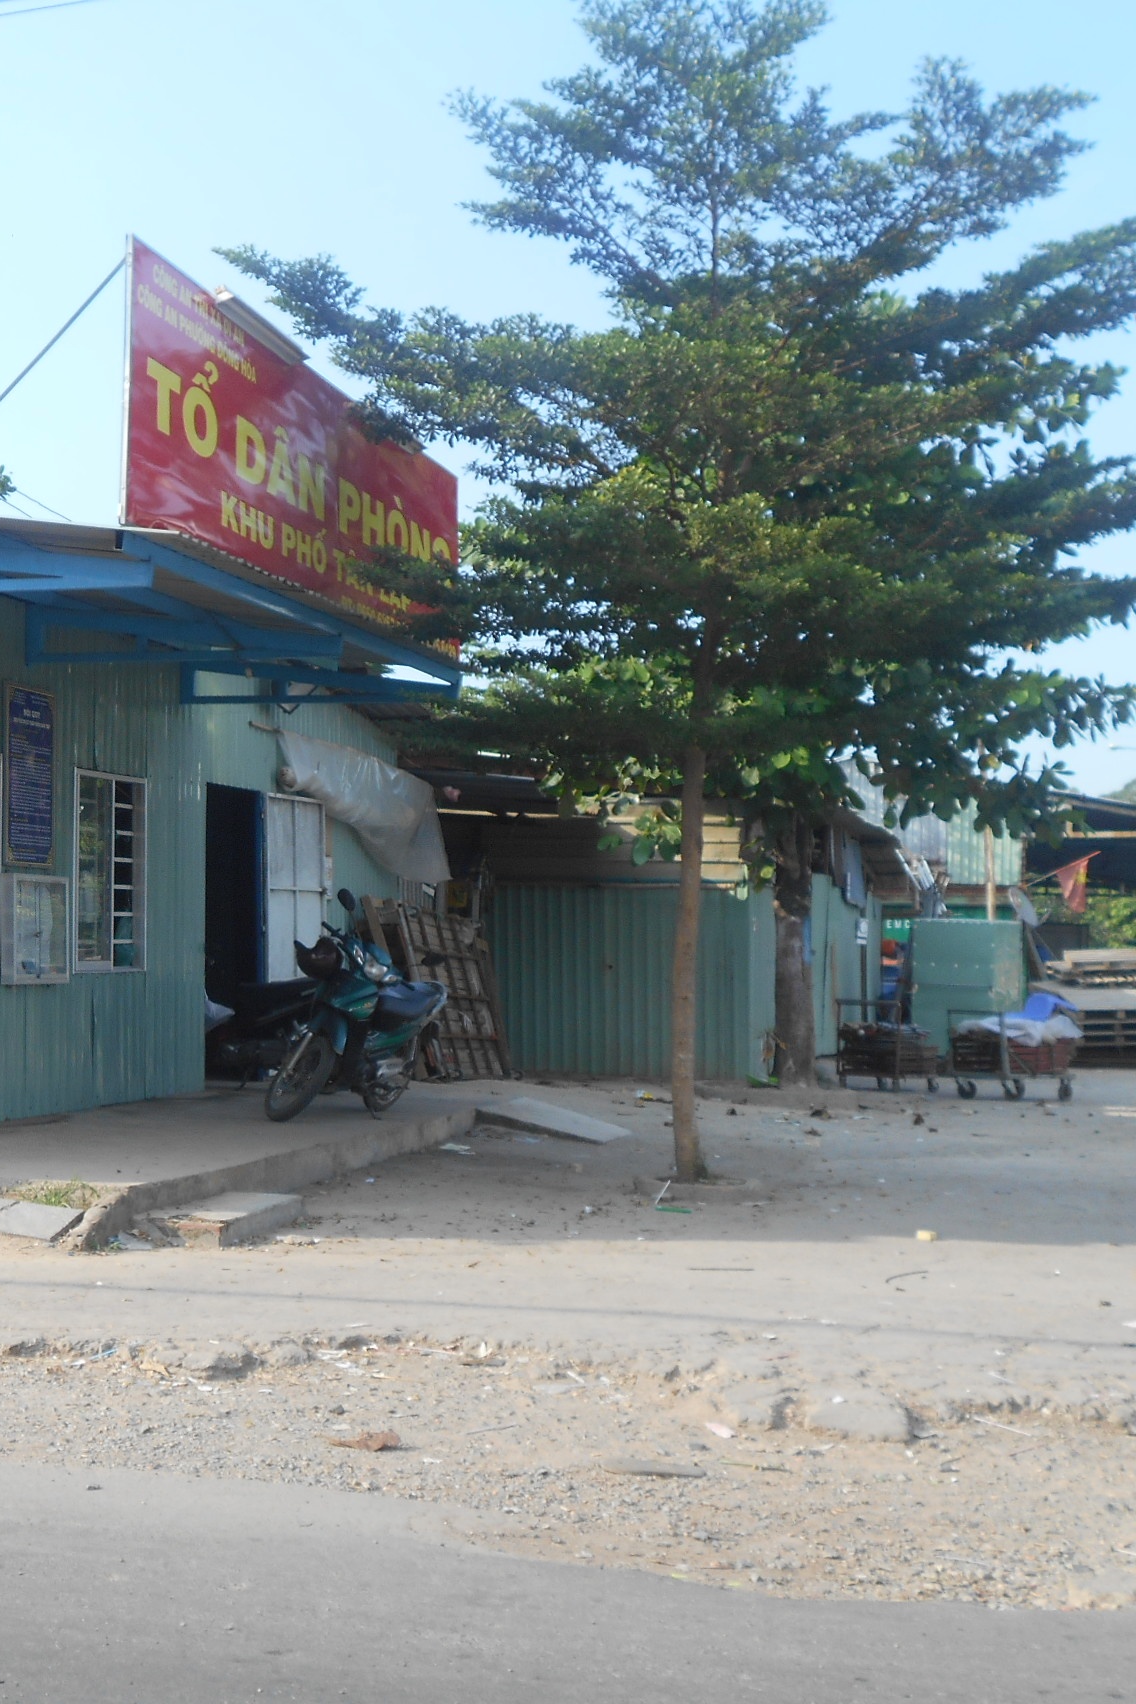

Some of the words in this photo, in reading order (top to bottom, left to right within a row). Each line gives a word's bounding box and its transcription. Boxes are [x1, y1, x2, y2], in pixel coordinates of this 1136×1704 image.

[147, 356, 219, 458] TỔ
[235, 414, 327, 521] DÂN
[220, 490, 275, 549] KHU
[281, 522, 328, 574] PHỐ
